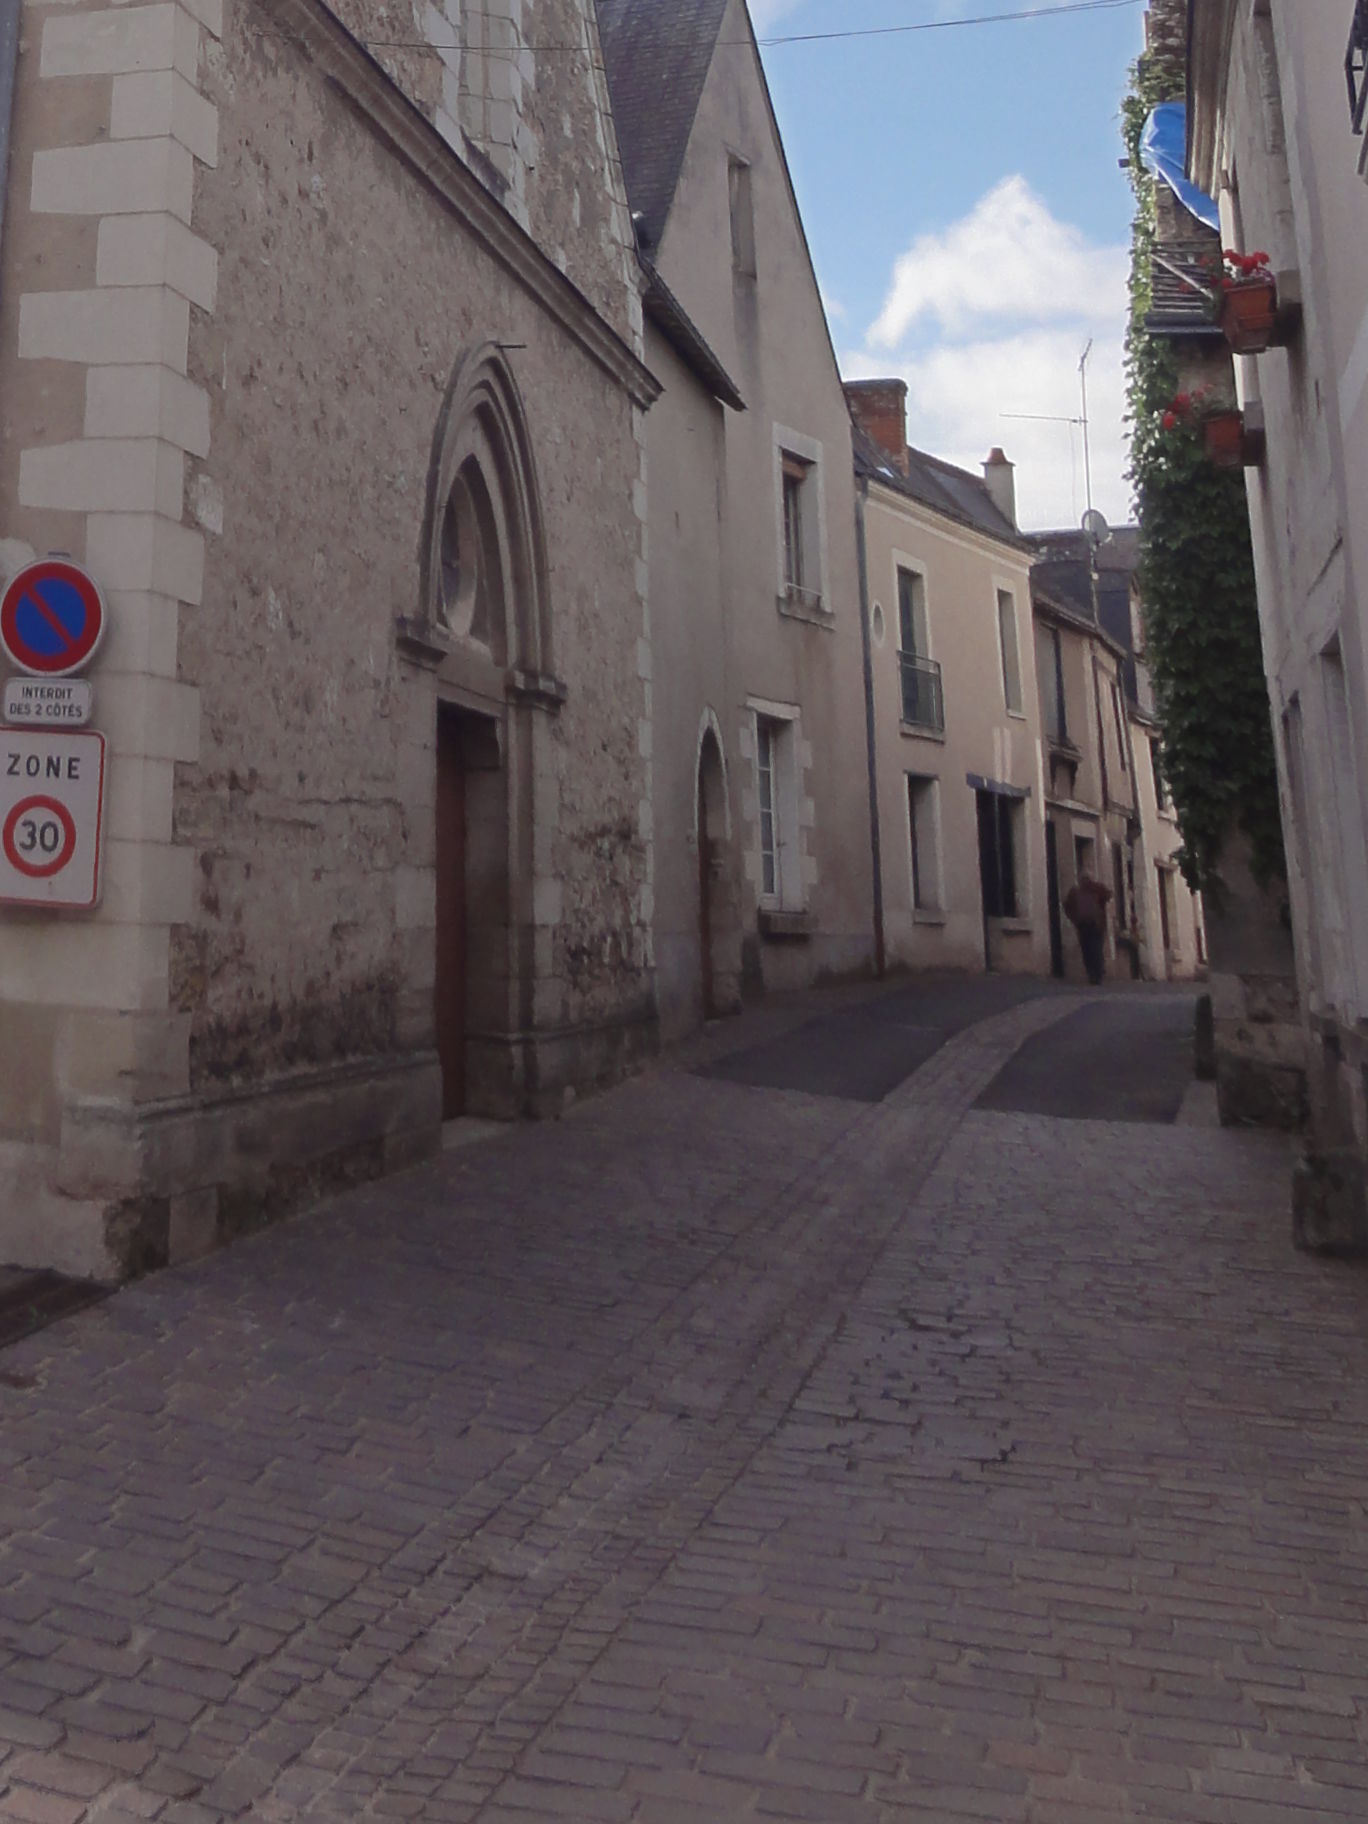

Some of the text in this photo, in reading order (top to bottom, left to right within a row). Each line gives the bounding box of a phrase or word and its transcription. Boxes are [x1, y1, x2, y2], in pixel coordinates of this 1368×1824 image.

[22, 686, 73, 700] INTERDIT
[9, 702, 82, 718] DES 2 CÔTÉS
[7, 753, 81, 780] ZONE
[19, 820, 59, 852] 30
